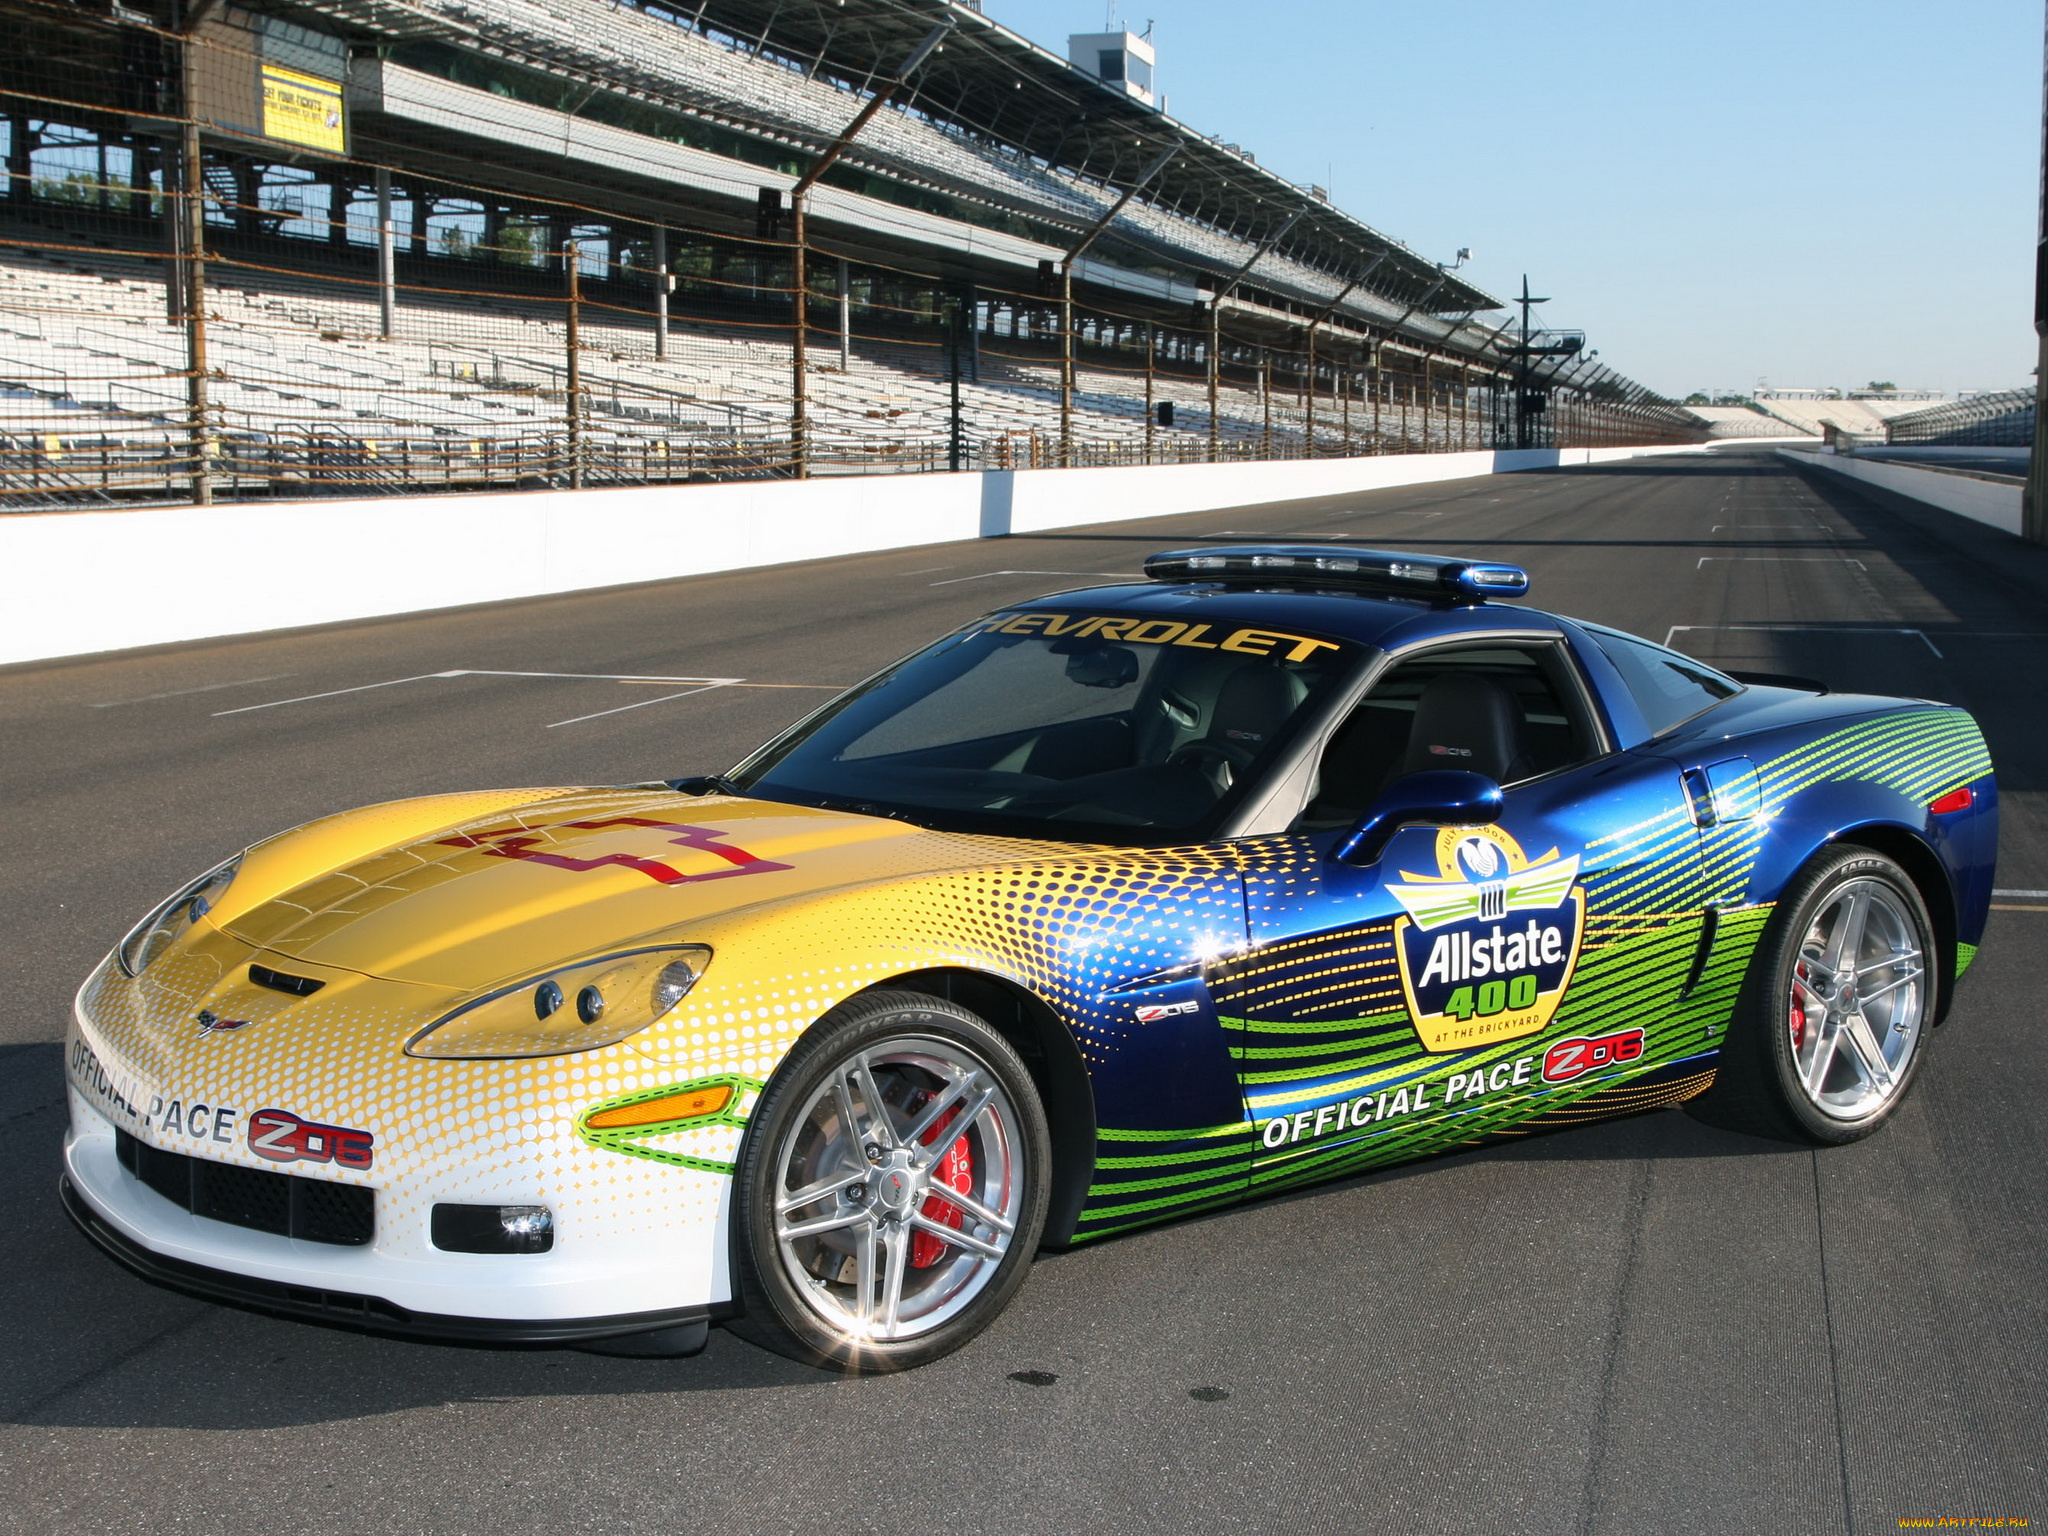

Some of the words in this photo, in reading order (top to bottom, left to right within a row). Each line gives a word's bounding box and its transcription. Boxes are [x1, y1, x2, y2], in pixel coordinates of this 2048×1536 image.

[1443, 829, 1457, 852] JULY
[1841, 860, 1885, 876] EAGLE
[1418, 919, 1562, 988] Allstate
[1444, 974, 1538, 1021] 400
[1434, 1032, 1449, 1044] AT
[1454, 1027, 1474, 1040] THE
[1479, 1014, 1540, 1035] BRICKYARD
[72, 1039, 138, 1118] OFFICIAL
[146, 1096, 237, 1144] PACE
[249, 1109, 374, 1170] Z06
[1262, 1083, 1431, 1149] OFFICIAL
[1444, 1056, 1535, 1104] PACE
[1544, 1028, 1644, 1082] Z06
